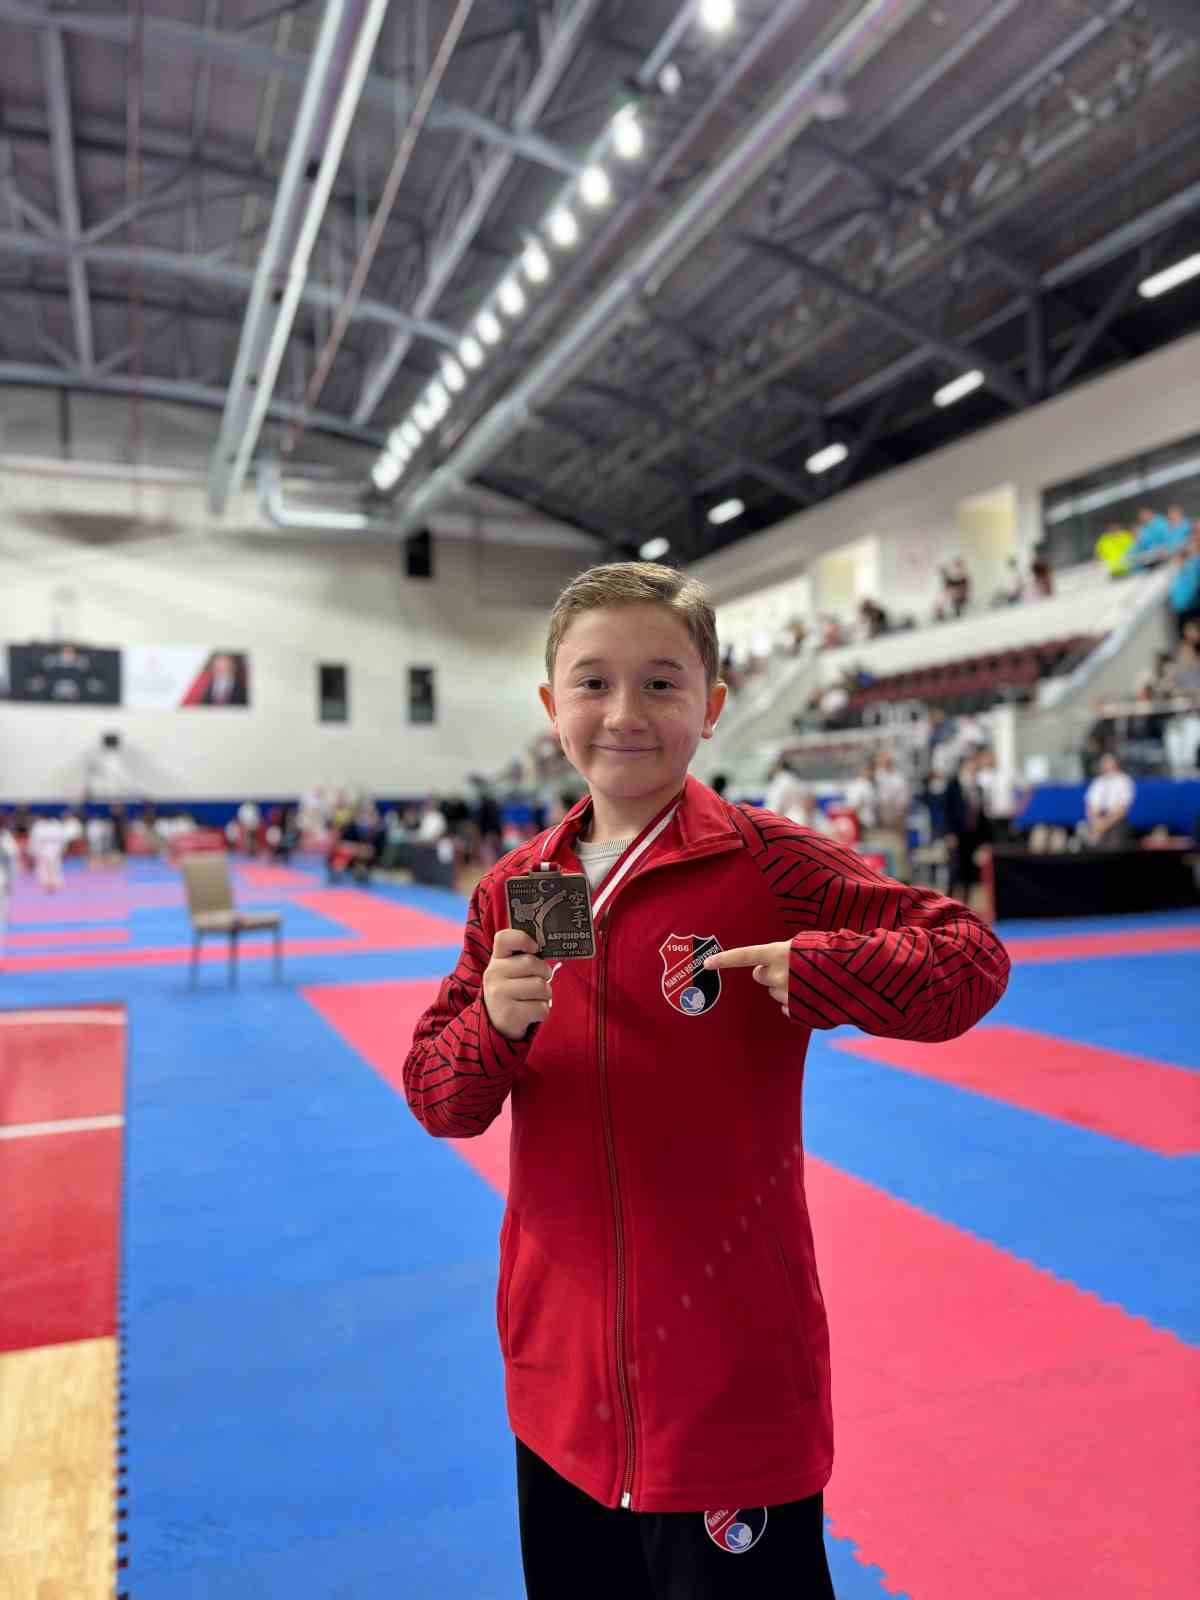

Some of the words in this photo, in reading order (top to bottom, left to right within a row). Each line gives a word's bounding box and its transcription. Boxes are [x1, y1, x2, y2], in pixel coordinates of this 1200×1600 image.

[547, 931, 591, 940] ASPENDOS
[562, 941, 578, 949] CUP
[666, 944, 689, 952] 1966
